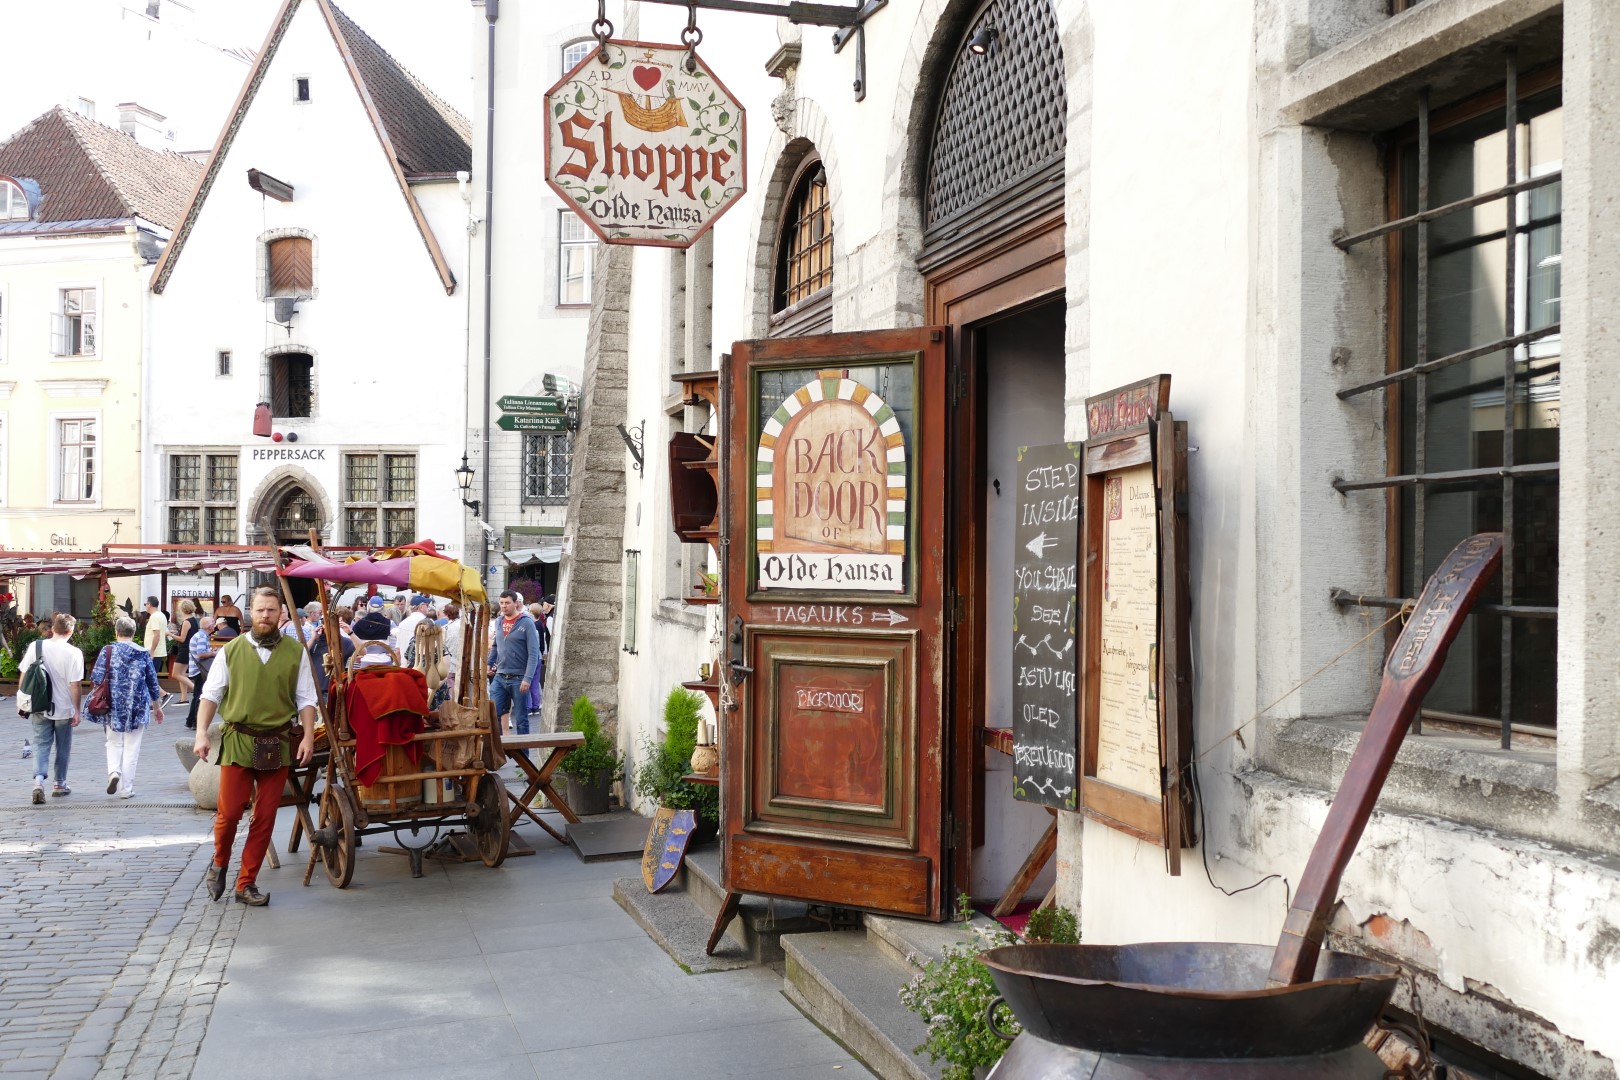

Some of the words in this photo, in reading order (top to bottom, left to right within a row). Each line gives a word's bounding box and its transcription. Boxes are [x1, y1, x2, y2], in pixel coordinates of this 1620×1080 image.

[678, 81, 709, 92] MMV
[555, 109, 735, 200] Shoppe
[588, 191, 641, 220] Olde
[514, 416, 544, 424] Katariina
[253, 449, 325, 460] PEPPERSACK
[794, 427, 884, 475] BACK
[1025, 463, 1077, 491] STEP
[794, 480, 883, 535] DOOR
[1022, 494, 1079, 526] INSIDE
[822, 526, 842, 540] OF
[763, 554, 818, 582] Olde
[1015, 567, 1041, 591] YOU
[1044, 565, 1076, 592] SHALL
[772, 605, 863, 625] TAGAUKS
[1017, 666, 1052, 688] ASTU
[1023, 703, 1060, 729] OLED
